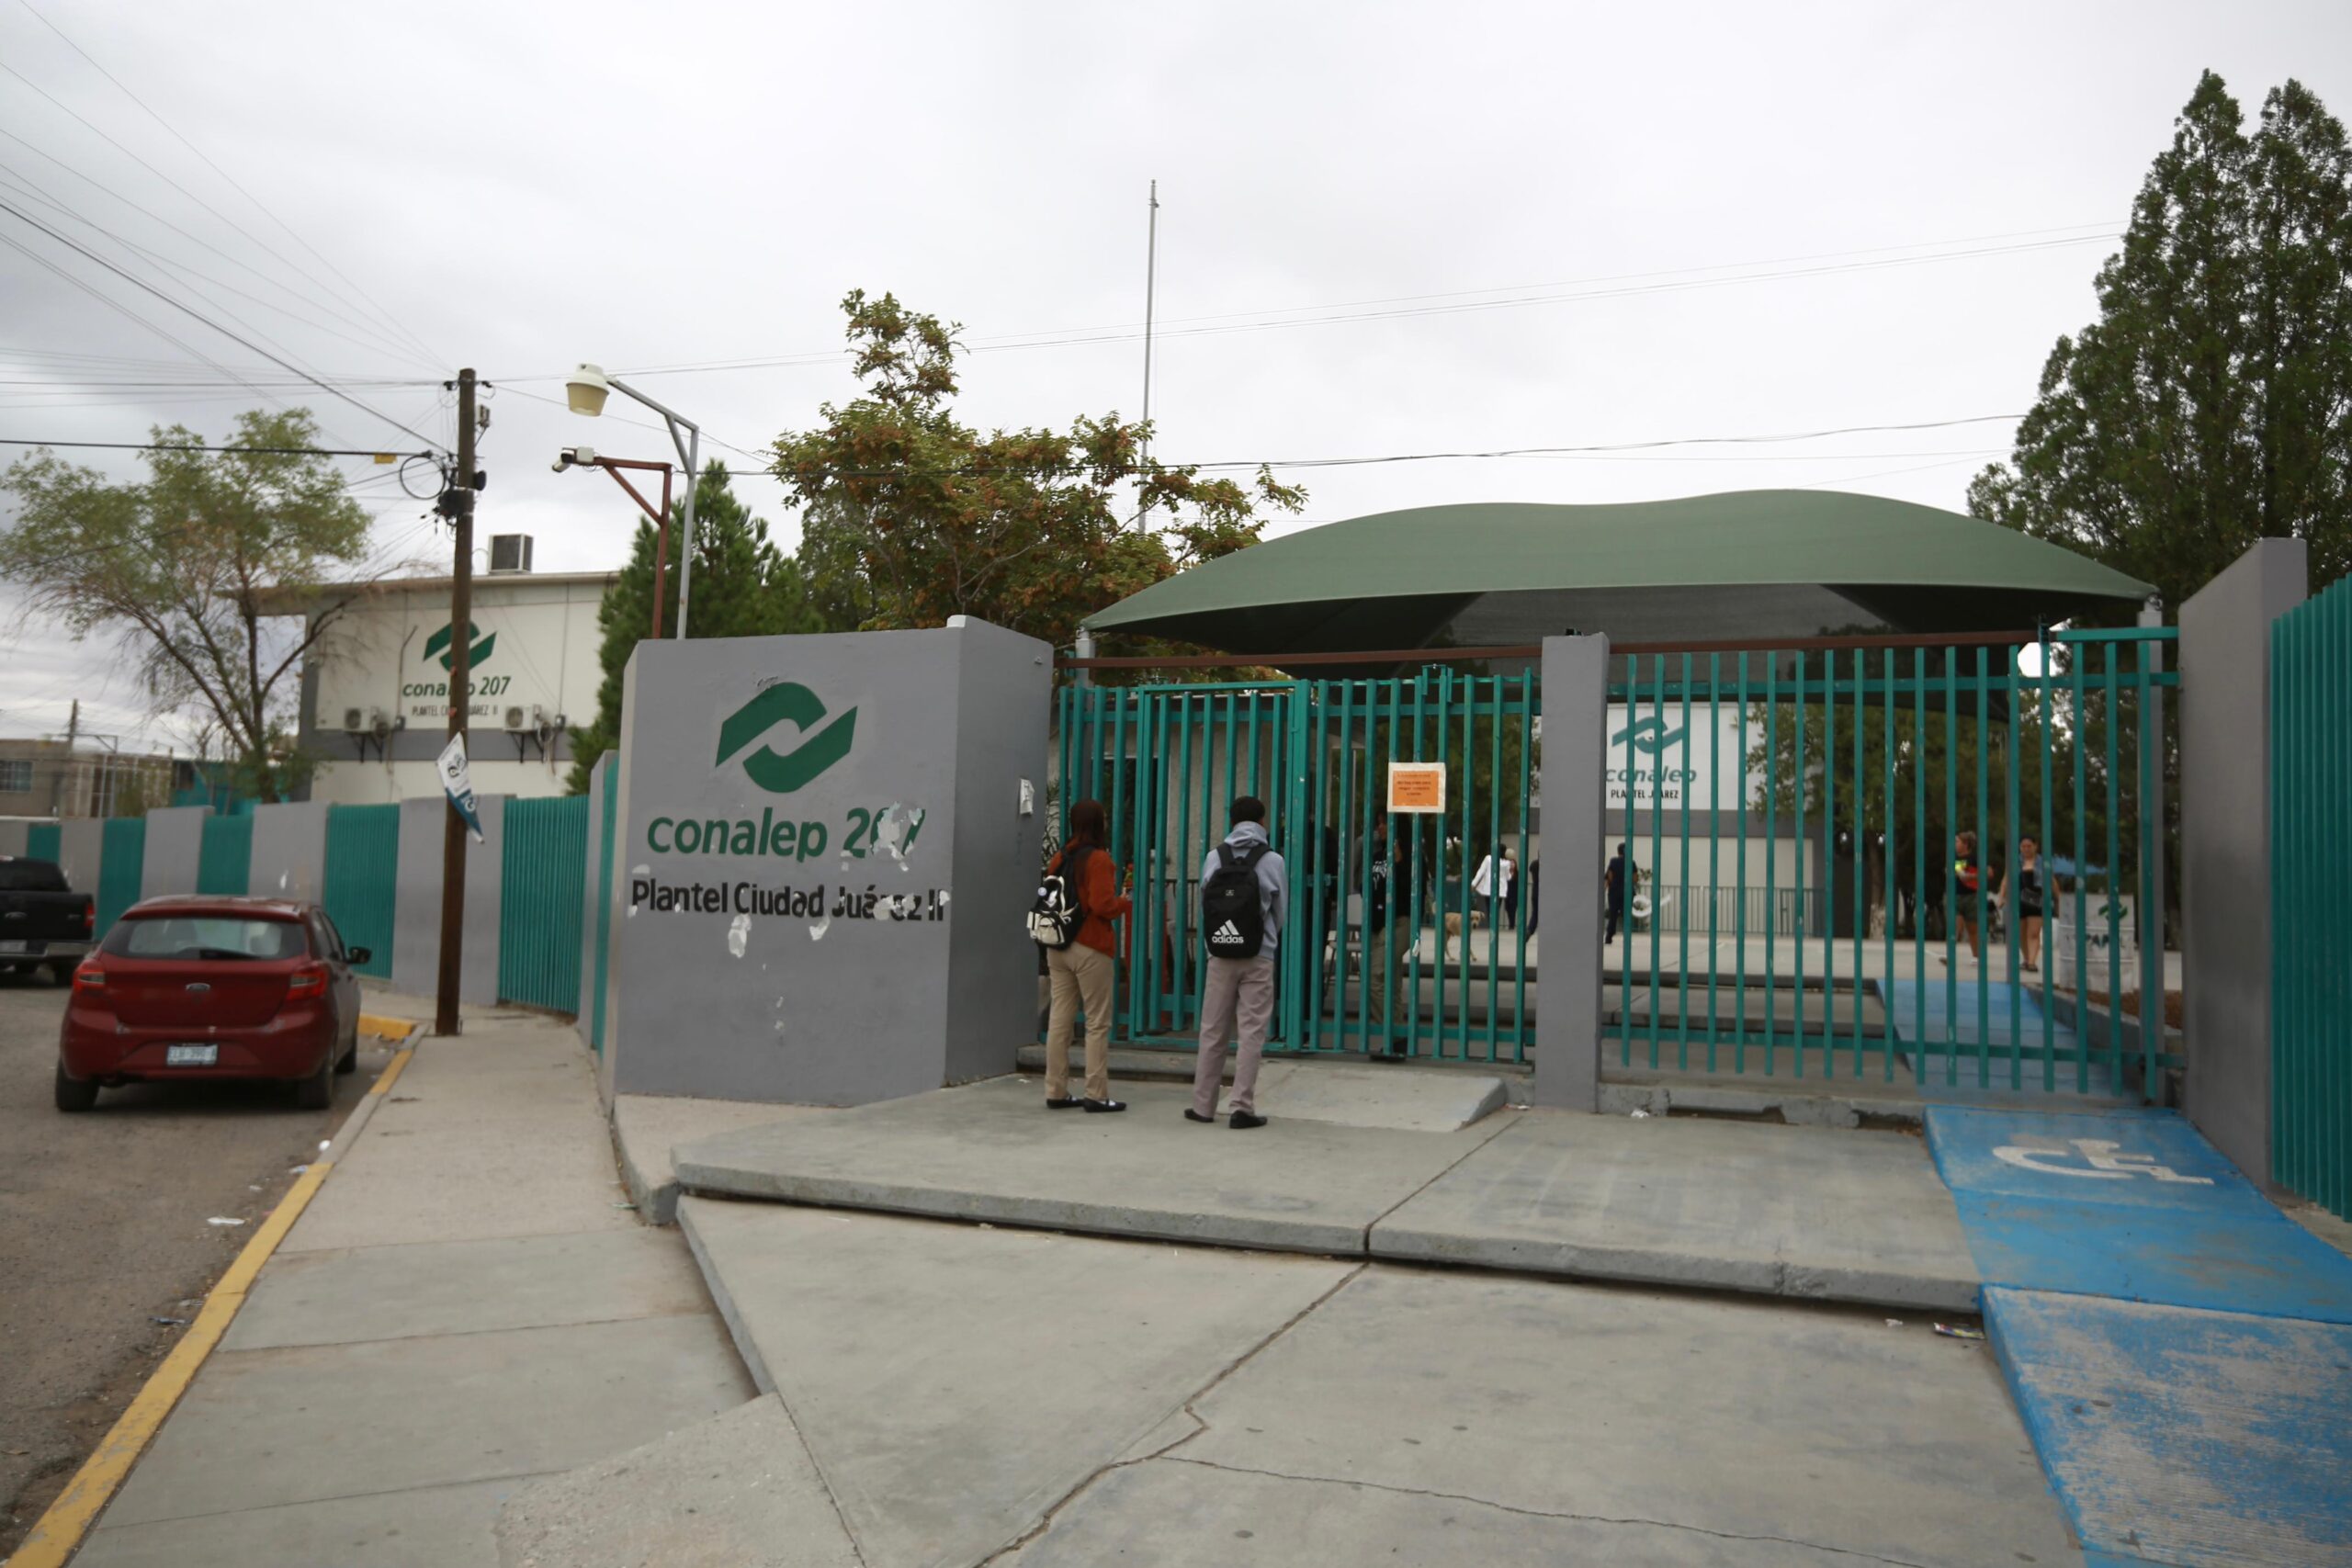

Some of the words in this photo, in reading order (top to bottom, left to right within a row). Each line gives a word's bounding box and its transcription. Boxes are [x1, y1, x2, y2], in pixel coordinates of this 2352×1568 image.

[402, 682, 476, 697] conap
[479, 675, 512, 696] 207
[412, 705, 437, 716] PLANTEL
[1606, 765, 1697, 783] conle
[1611, 790, 1645, 799] PLATEL
[1647, 790, 1679, 799] JAREZ
[647, 807, 828, 863] conalep
[843, 807, 926, 859] 27
[632, 878, 729, 913] Plantel
[734, 882, 824, 919] Ciudad
[831, 884, 922, 921] Juáez
[1212, 935, 1244, 943] adidas
